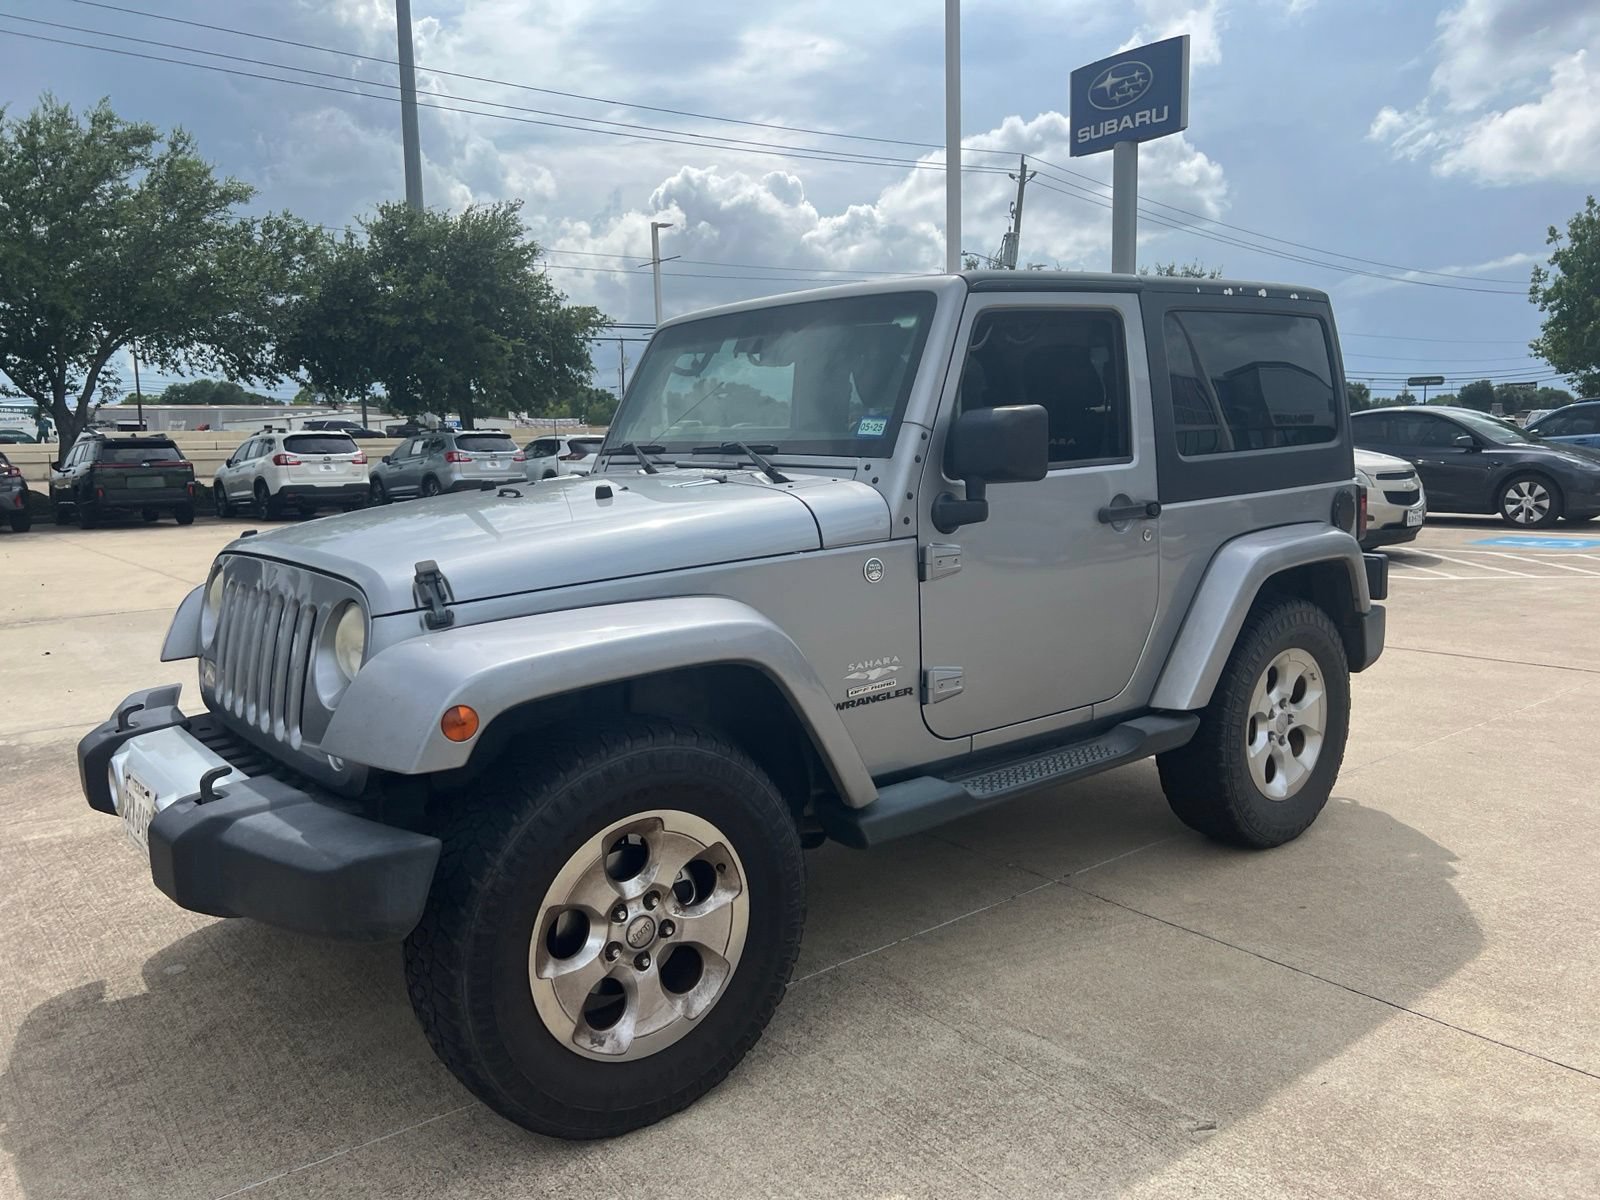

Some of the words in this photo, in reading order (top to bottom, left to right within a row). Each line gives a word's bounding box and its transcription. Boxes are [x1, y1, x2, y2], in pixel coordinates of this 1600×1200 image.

[1077, 105, 1169, 143] SUBARU
[847, 655, 901, 672] SAHARA
[833, 686, 914, 711] WRANGLER
[632, 920, 651, 943] Jeep
